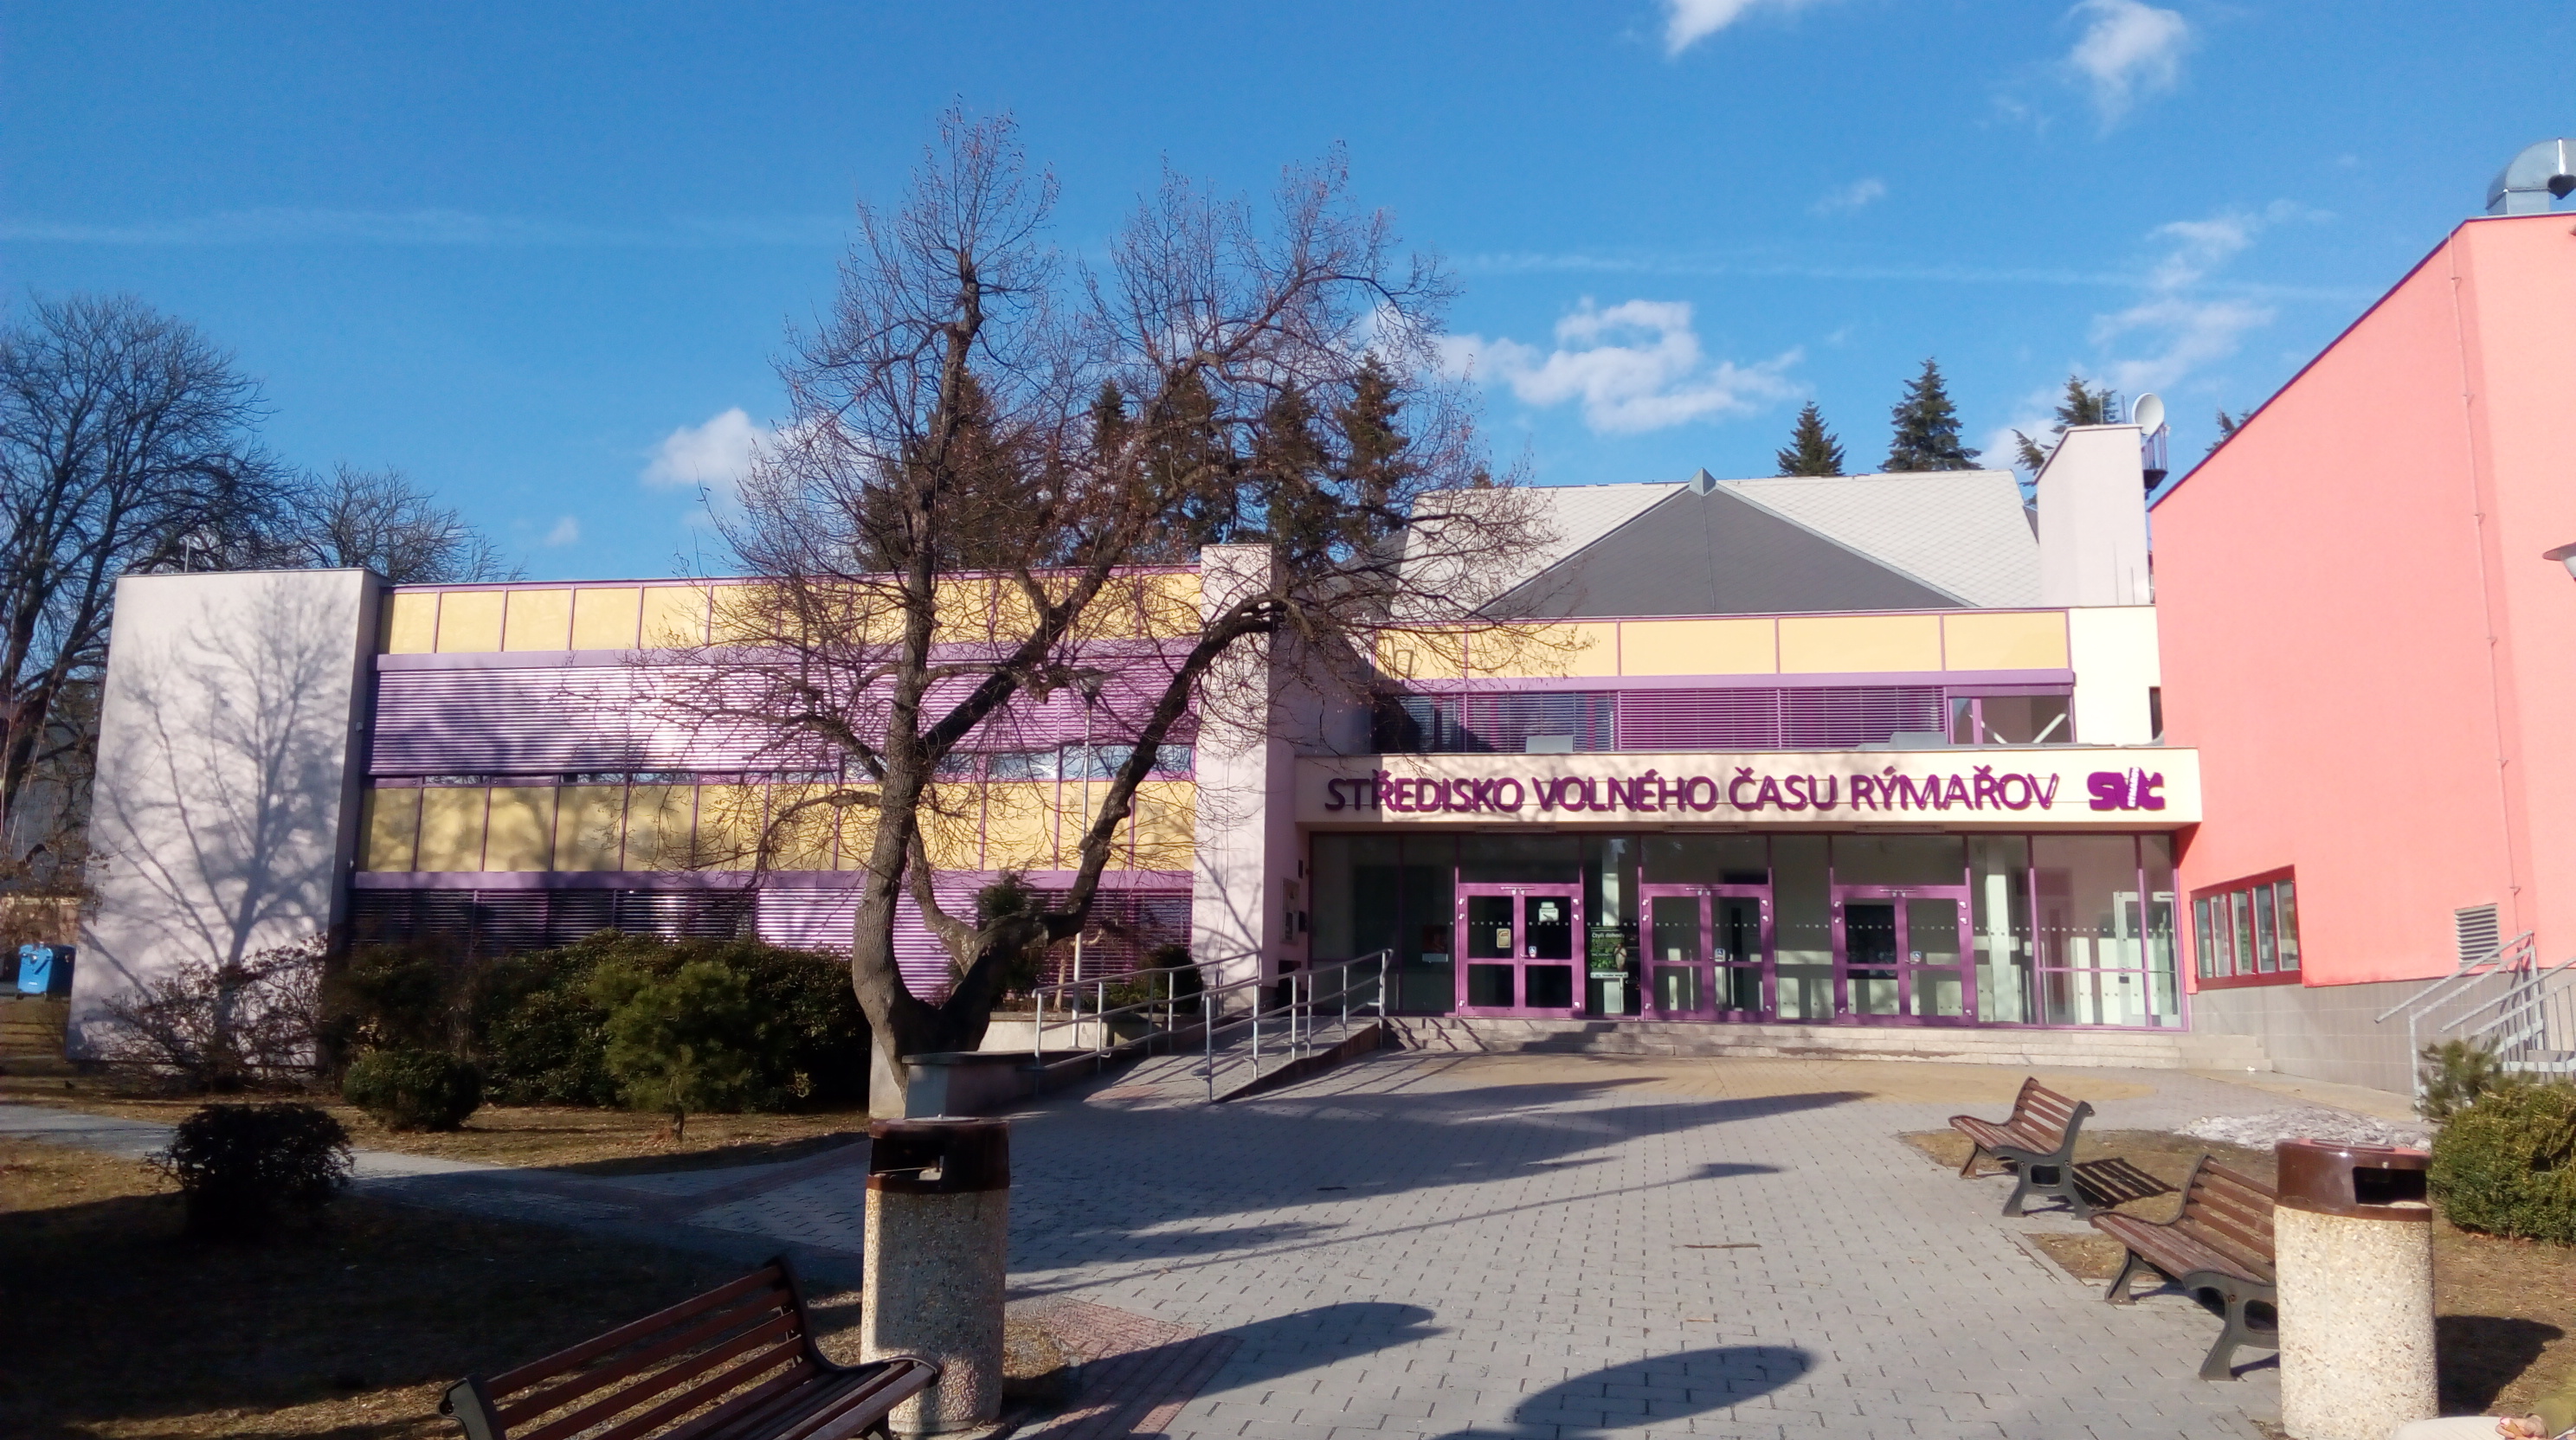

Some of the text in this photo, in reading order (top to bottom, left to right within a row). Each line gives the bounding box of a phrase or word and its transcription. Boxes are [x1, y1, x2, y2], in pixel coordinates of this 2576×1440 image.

[1325, 764, 2060, 813] STŘEDISKO VOLNÉHO ČASU RÝMAŘOV
